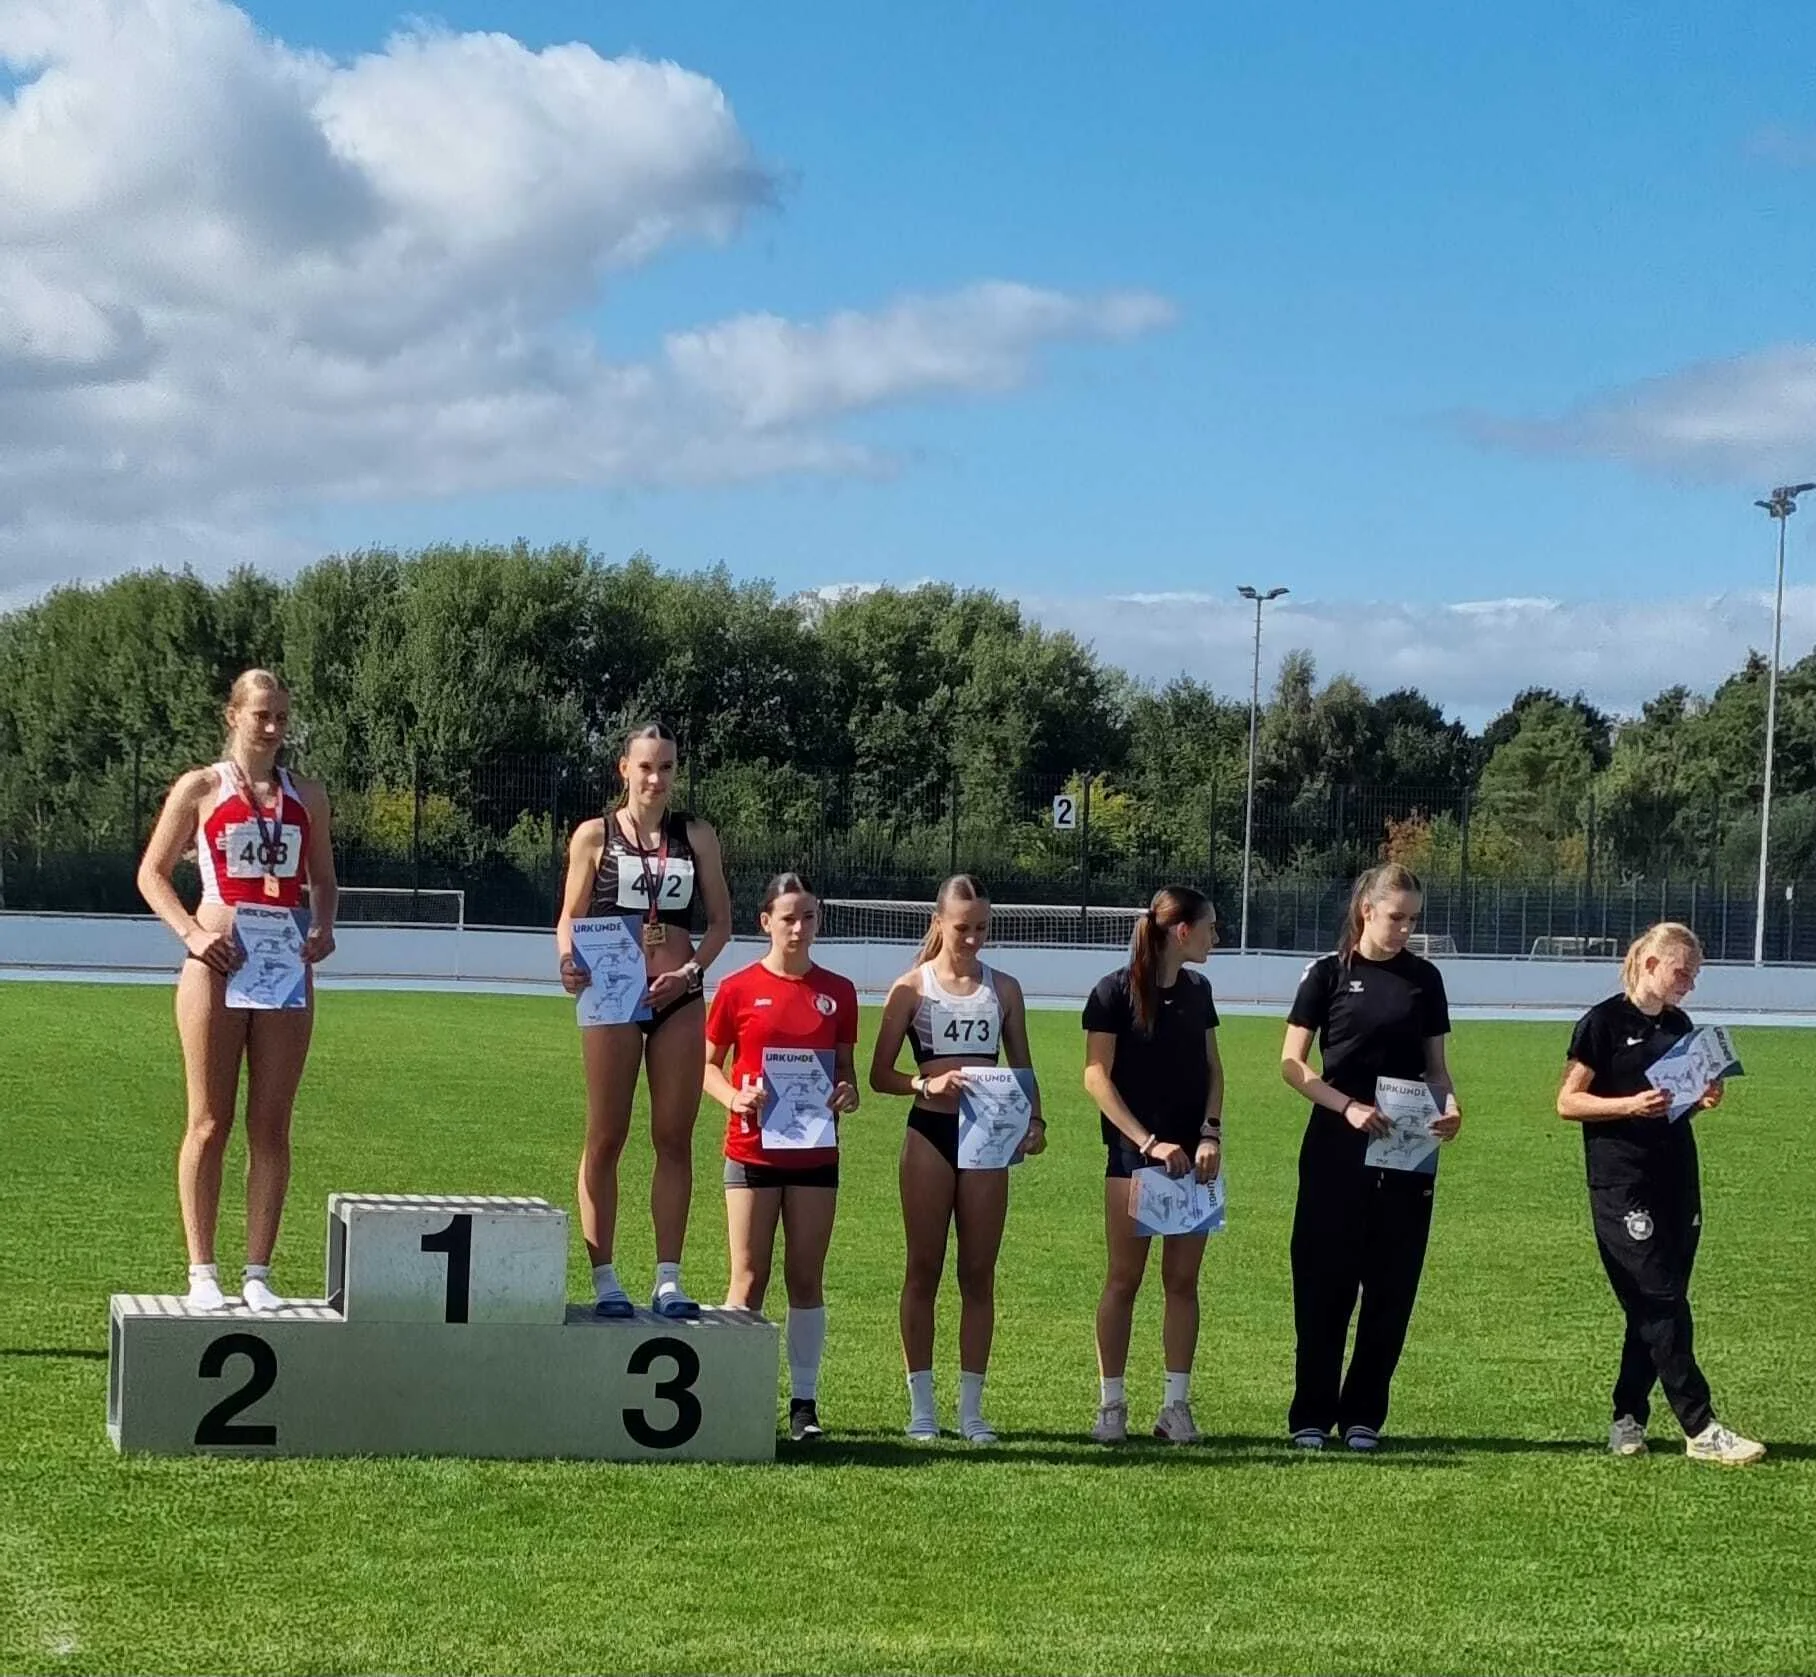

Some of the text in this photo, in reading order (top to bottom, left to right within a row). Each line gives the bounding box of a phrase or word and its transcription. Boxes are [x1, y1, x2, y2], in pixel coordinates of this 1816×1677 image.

[1058, 798, 1072, 825] 2
[573, 922, 623, 933] URKUNDE
[943, 1019, 990, 1042] 473
[765, 1053, 814, 1064] URKUNDE
[1379, 1083, 1429, 1097] URKUNDE
[420, 1214, 473, 1324] 1
[194, 1333, 278, 1446] 2
[621, 1337, 703, 1450] 3
